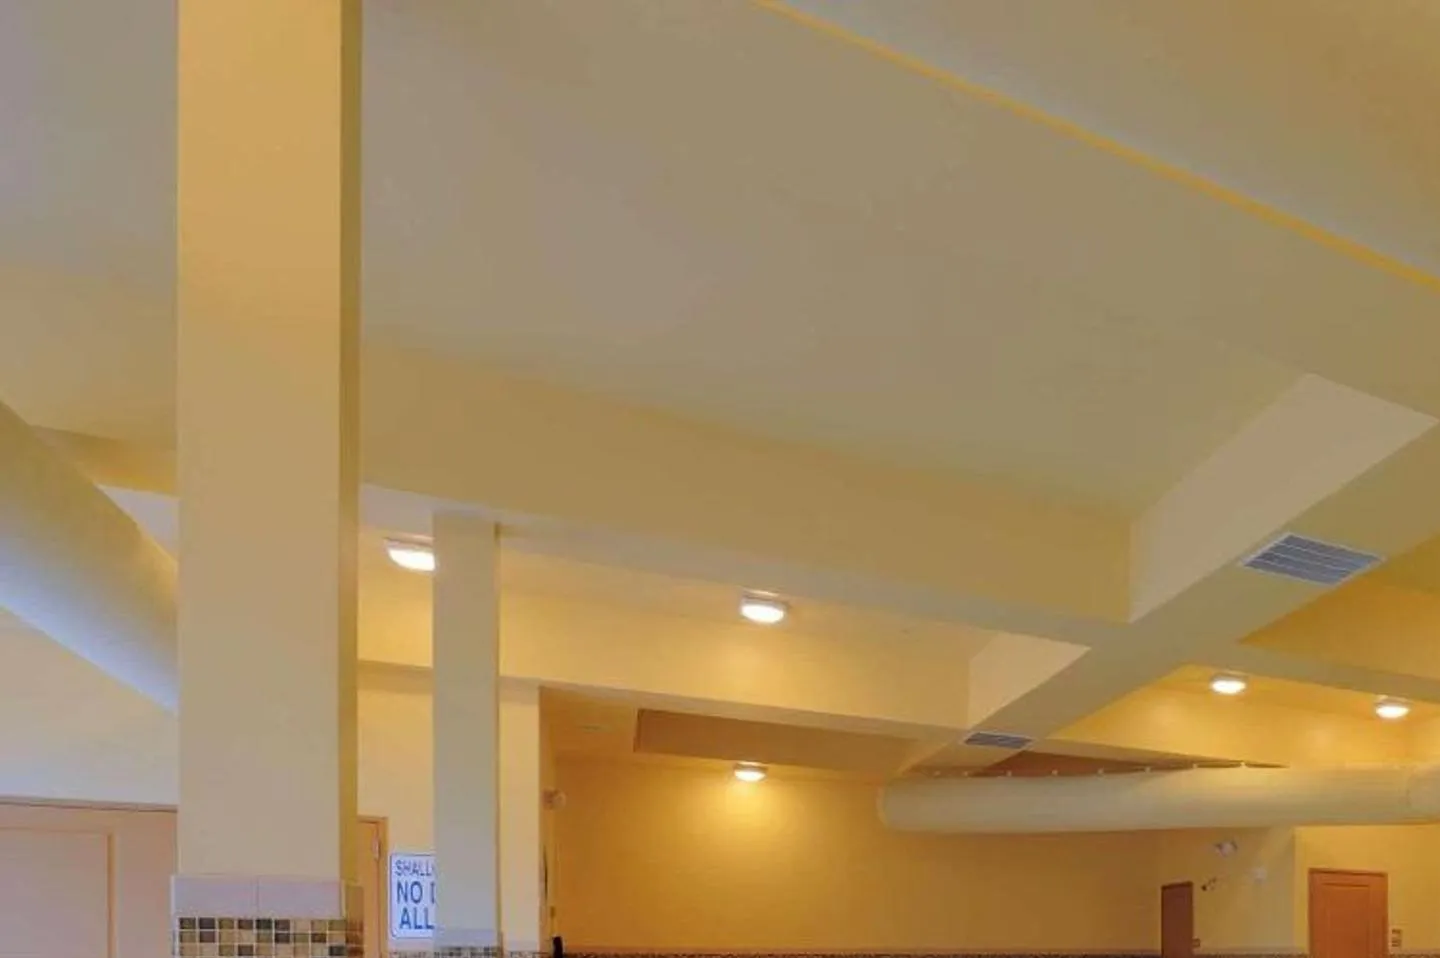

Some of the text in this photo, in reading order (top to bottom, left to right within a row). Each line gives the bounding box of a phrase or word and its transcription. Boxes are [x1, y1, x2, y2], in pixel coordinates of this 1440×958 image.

[395, 859, 435, 877] SHALL
[397, 881, 423, 904] NO
[400, 907, 435, 930] ALL
